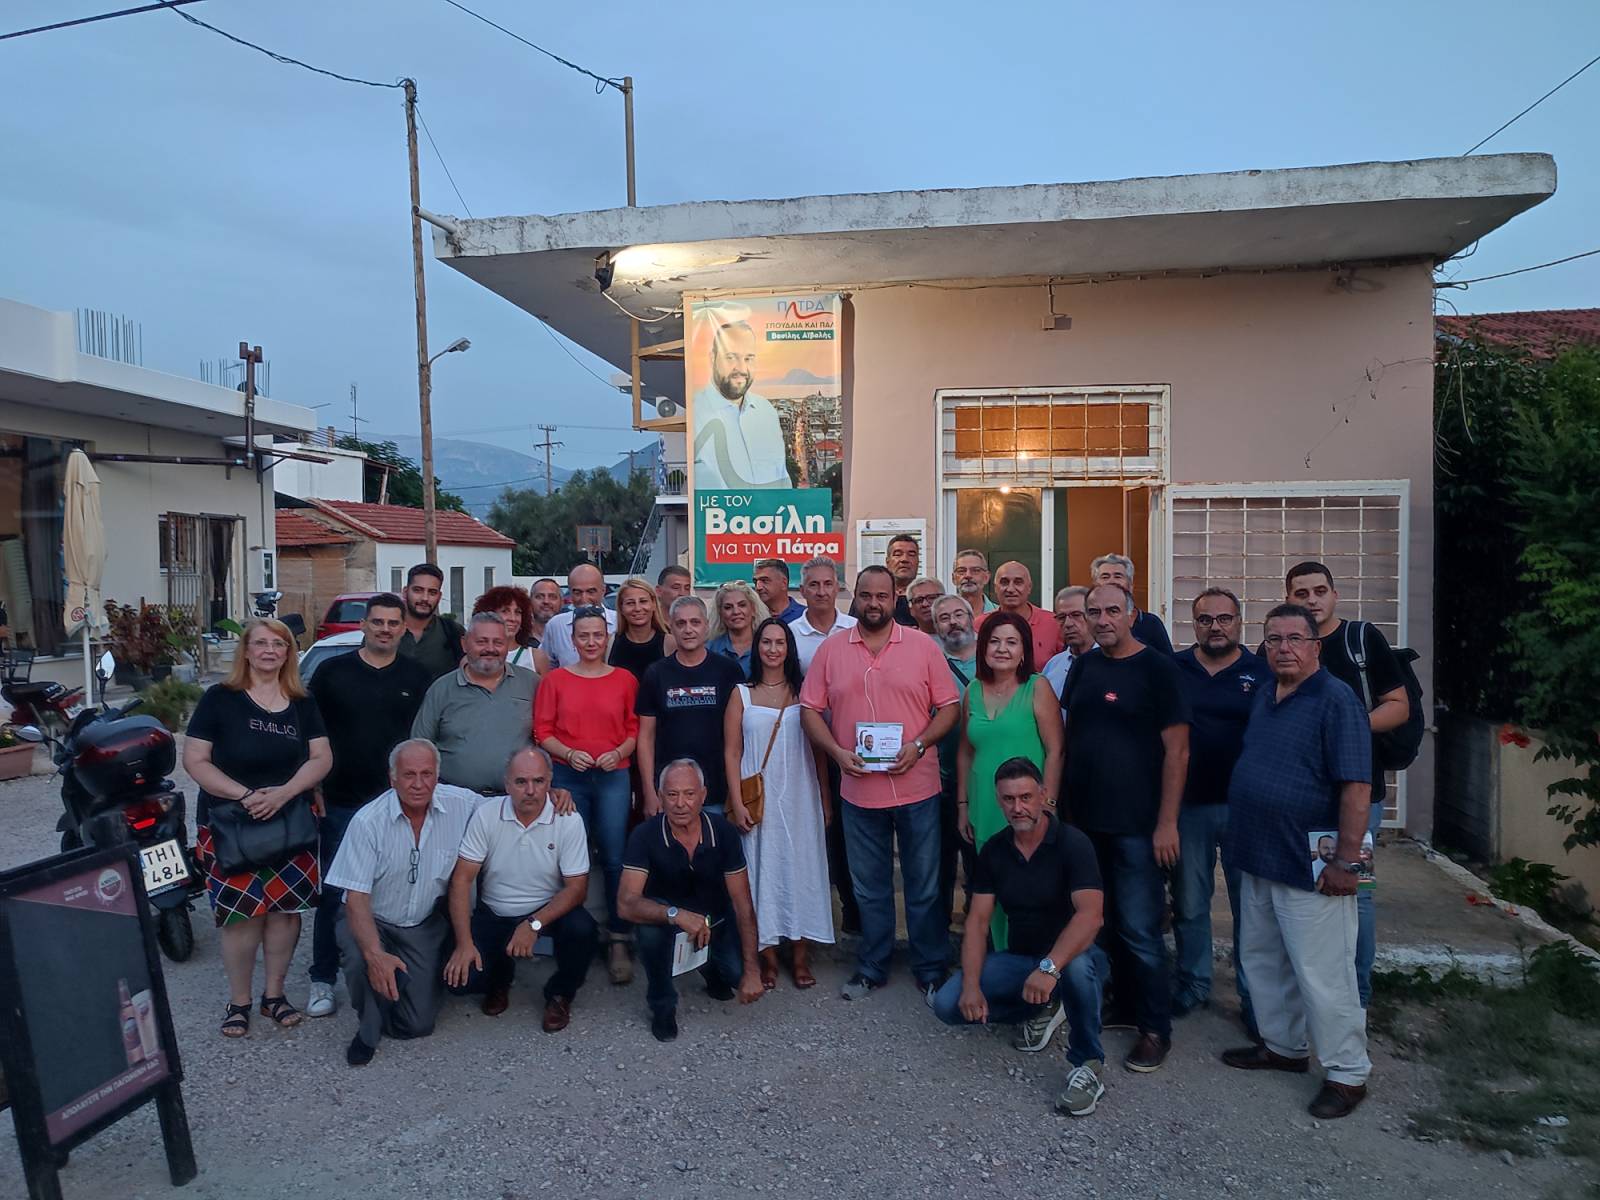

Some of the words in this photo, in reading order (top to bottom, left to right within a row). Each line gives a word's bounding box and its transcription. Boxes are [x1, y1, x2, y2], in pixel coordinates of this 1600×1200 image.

[700, 495, 719, 511] με
[724, 495, 752, 507] τον
[705, 505, 825, 534] Βασίλη
[712, 543, 737, 559] για
[743, 543, 771, 555] την
[777, 537, 839, 558] Πάτρα
[144, 845, 176, 865] THI
[153, 863, 184, 883] 484
